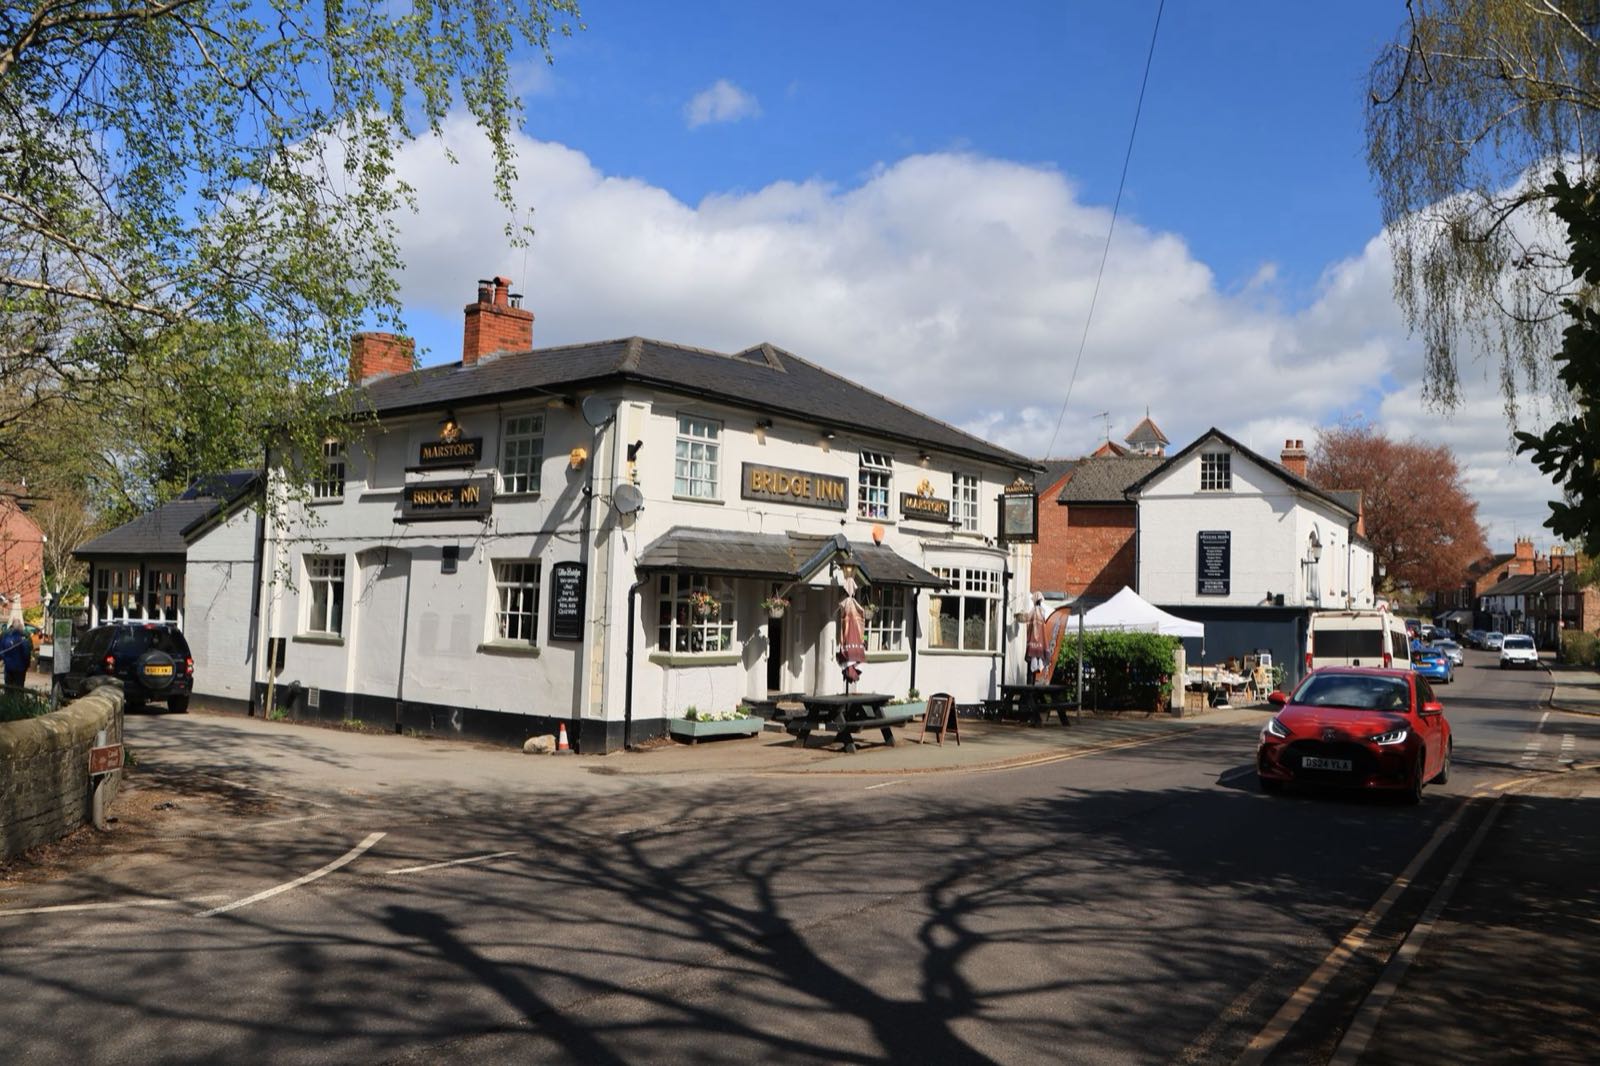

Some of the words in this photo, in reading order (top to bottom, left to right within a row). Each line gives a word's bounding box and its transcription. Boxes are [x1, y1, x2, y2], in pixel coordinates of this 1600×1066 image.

[413, 488, 454, 505] BRIDGE
[752, 469, 810, 497] BRIDGE
[816, 478, 844, 501] INN
